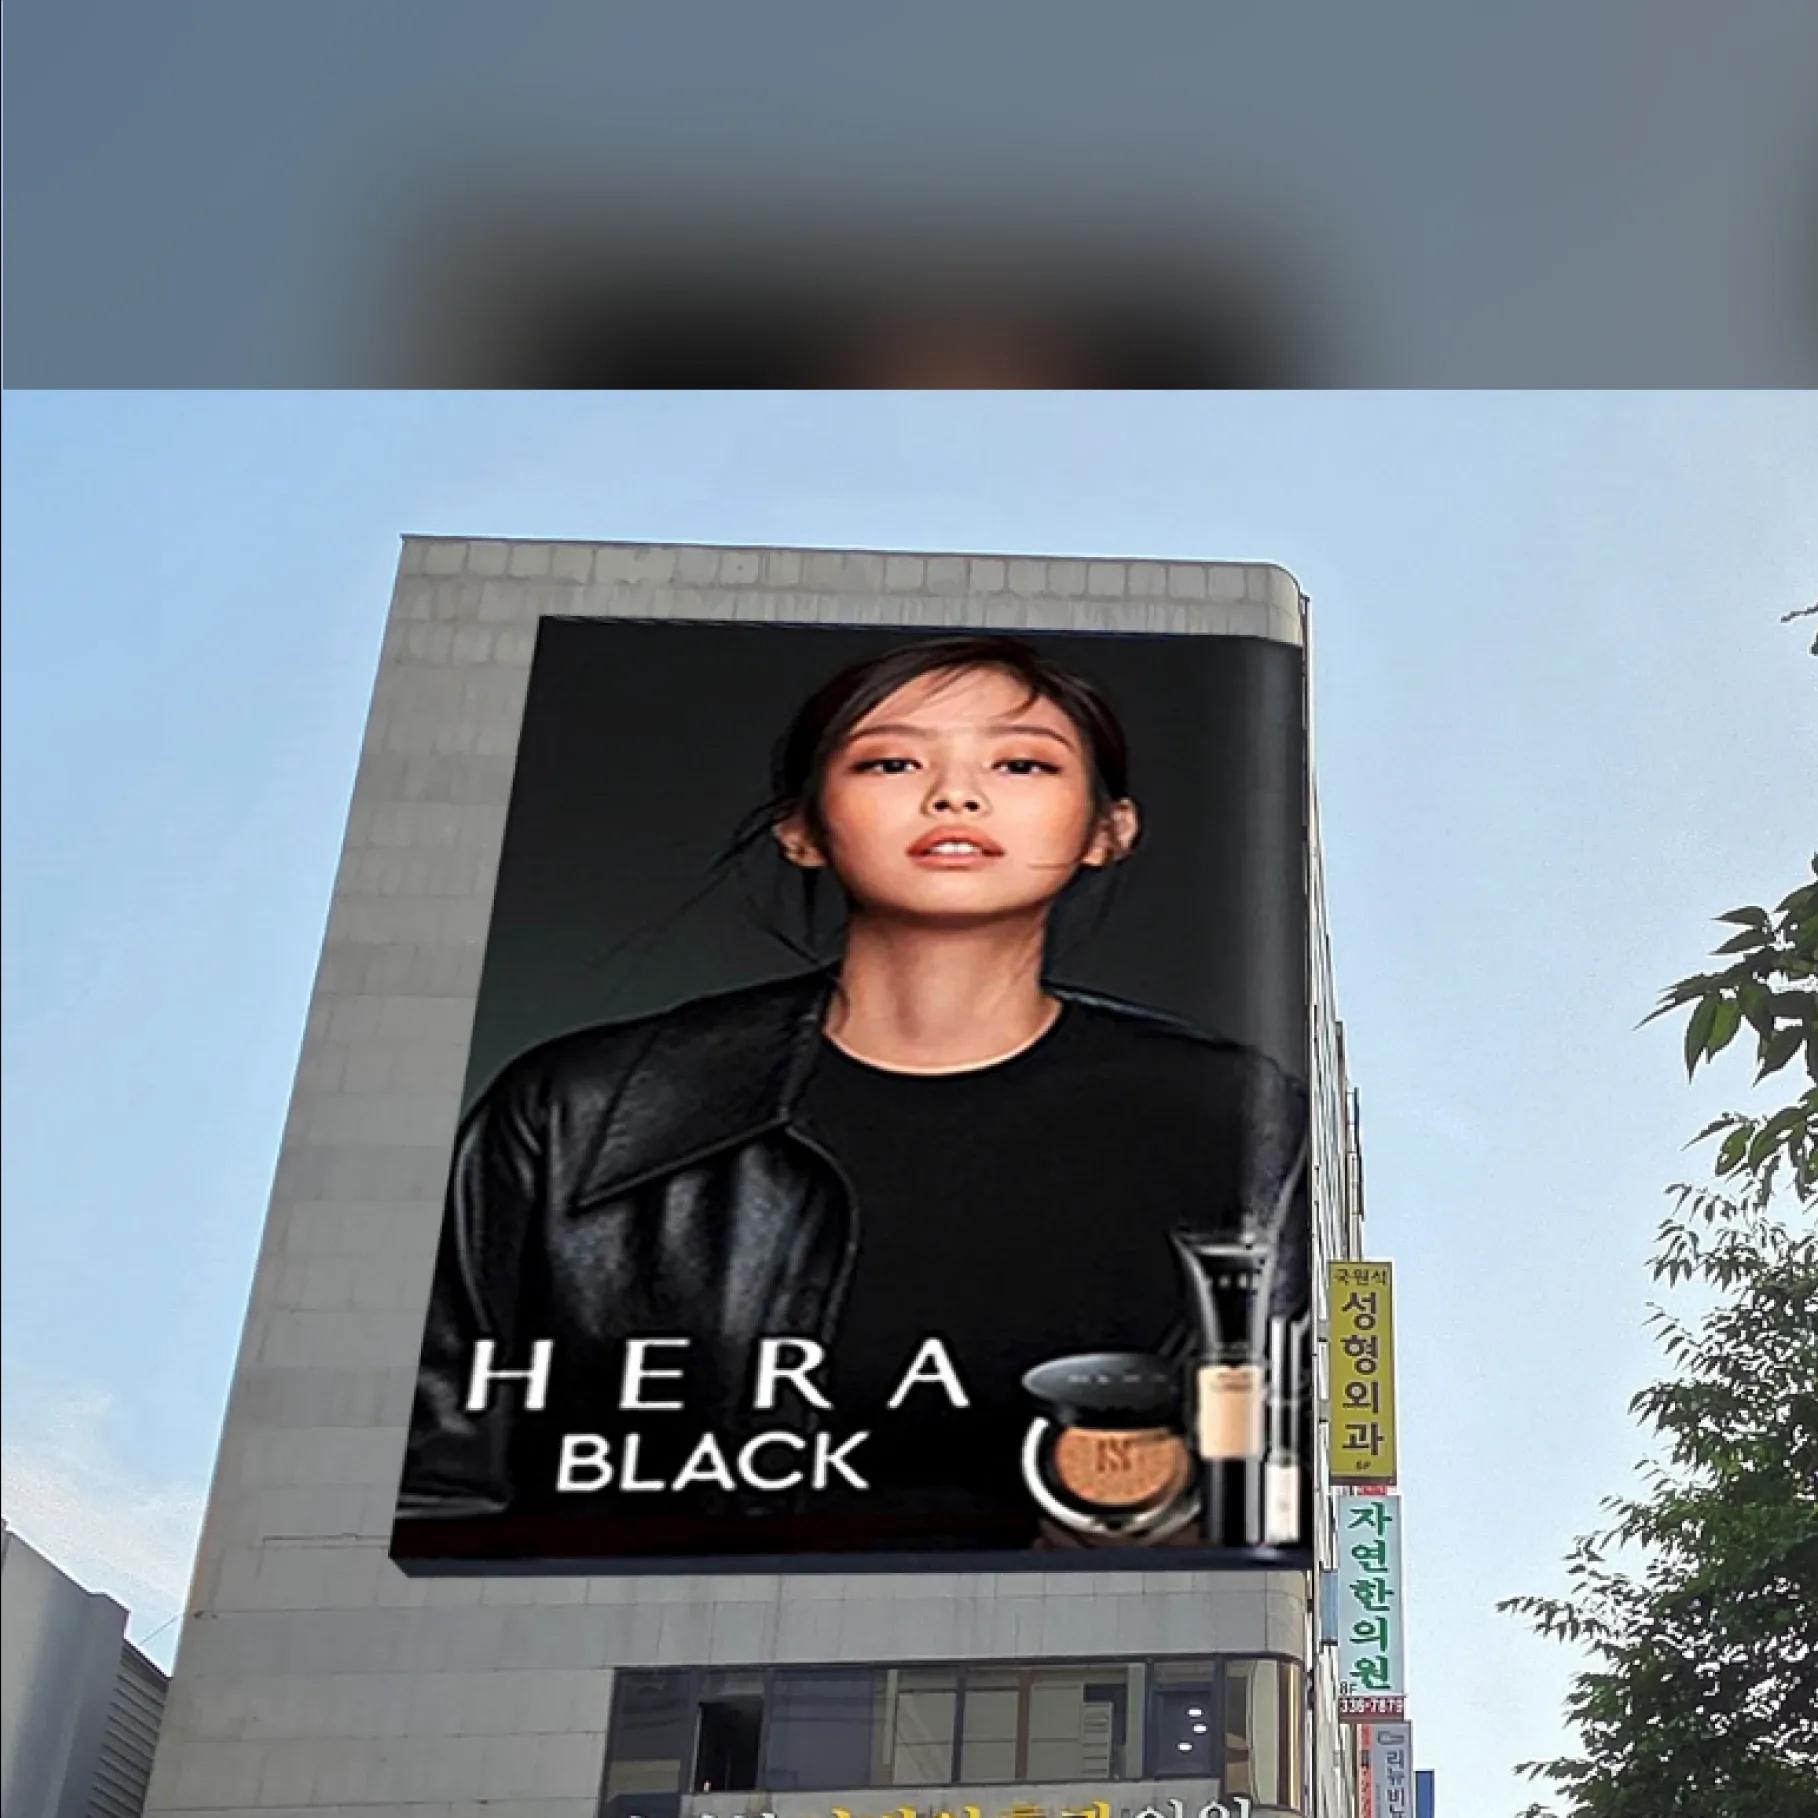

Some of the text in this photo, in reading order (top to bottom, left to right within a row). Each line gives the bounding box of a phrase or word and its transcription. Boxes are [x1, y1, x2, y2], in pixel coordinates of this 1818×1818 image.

[465, 1337, 970, 1412] HERA
[1341, 1291, 1385, 1456] 성형외과
[555, 1430, 871, 1494] BLACK
[1348, 1501, 1395, 1690] 자연한의원
